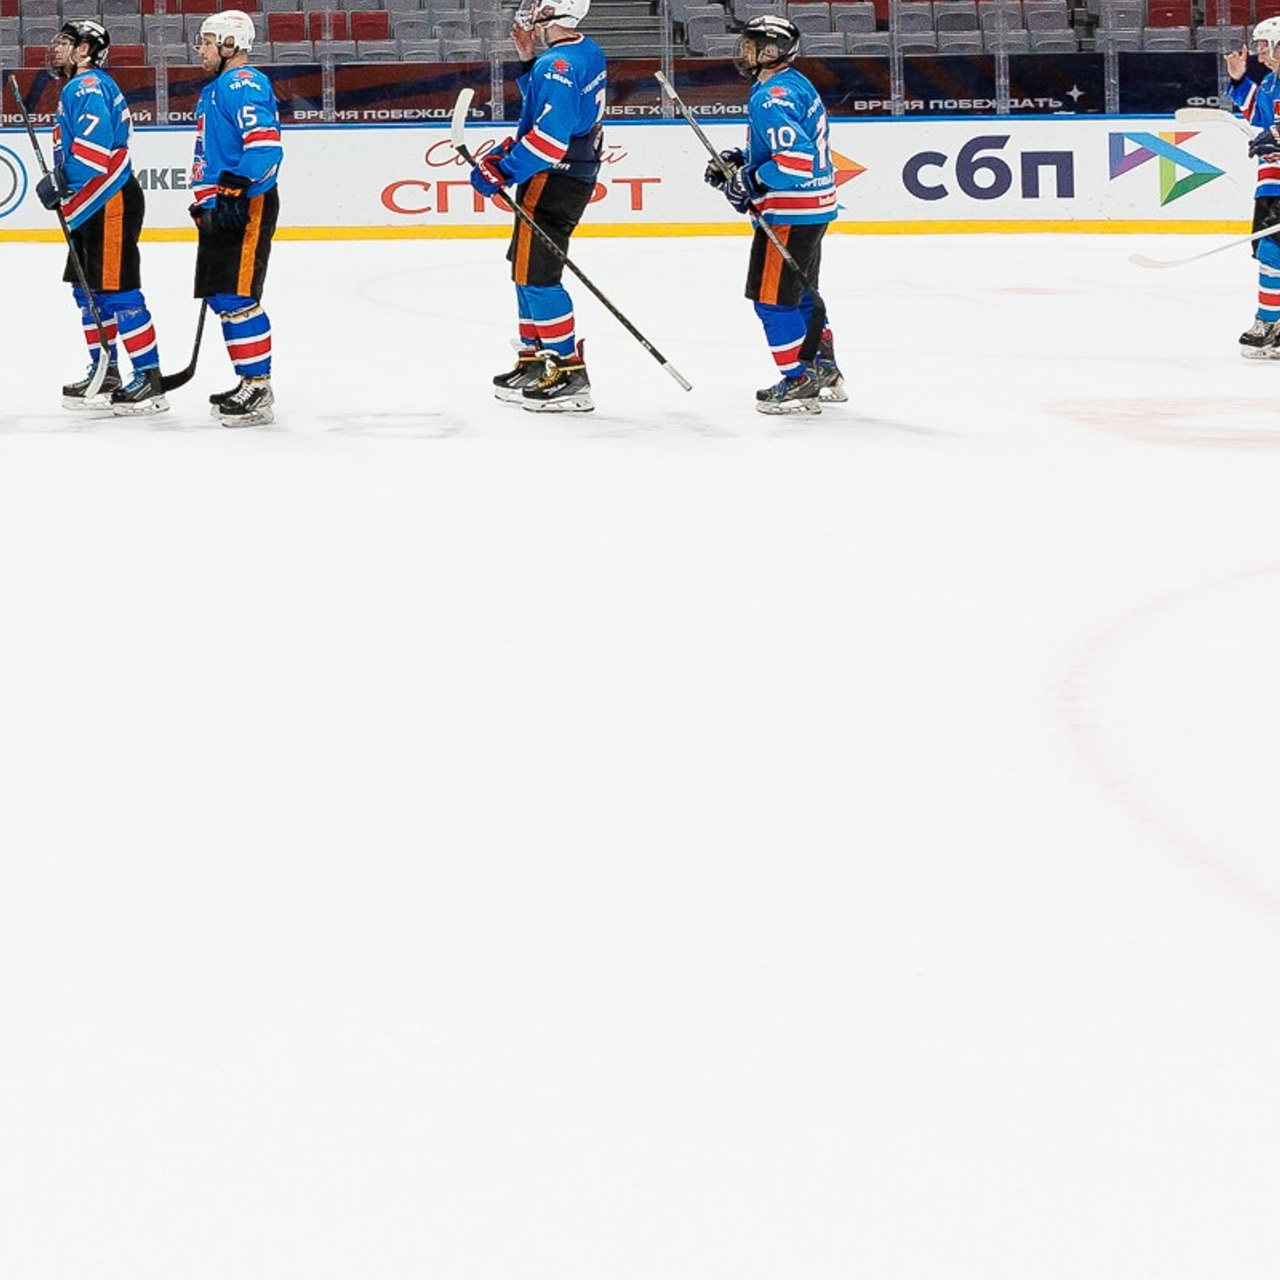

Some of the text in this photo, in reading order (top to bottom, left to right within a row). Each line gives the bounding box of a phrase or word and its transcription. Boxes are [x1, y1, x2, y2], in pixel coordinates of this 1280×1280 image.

[293, 110, 359, 120] ВРЕМЯ
[854, 97, 1064, 111] ВРЕМЯ ПОБЕЖДАТЬ
[237, 105, 258, 129] 15
[766, 126, 797, 150] 10
[902, 135, 1075, 201] сбп
